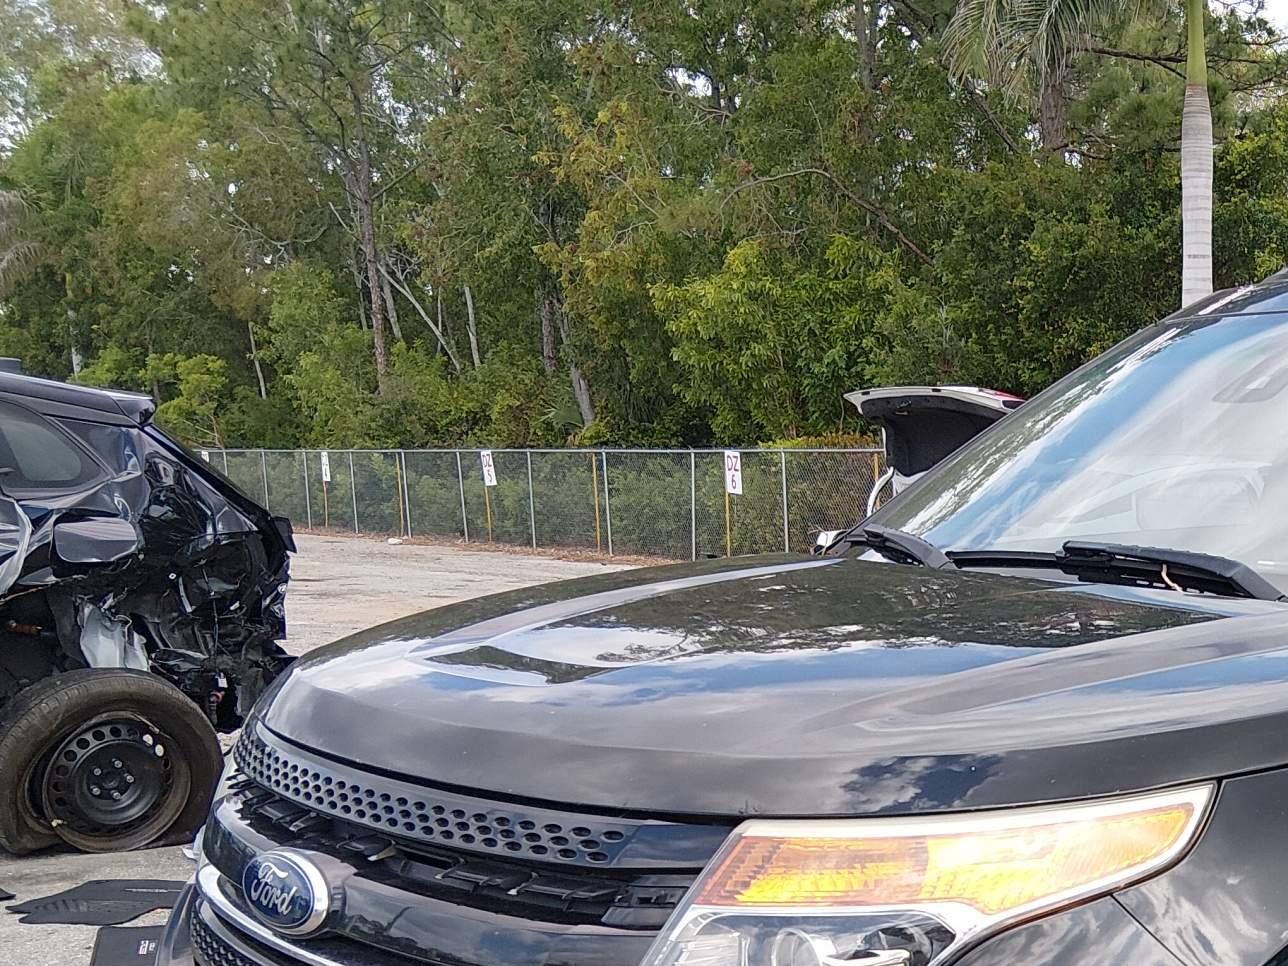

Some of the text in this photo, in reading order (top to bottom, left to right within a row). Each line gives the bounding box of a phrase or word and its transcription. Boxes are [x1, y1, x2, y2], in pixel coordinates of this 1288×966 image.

[726, 455, 740, 472] DZ
[731, 474, 737, 490] 6
[251, 862, 298, 916] Ford
